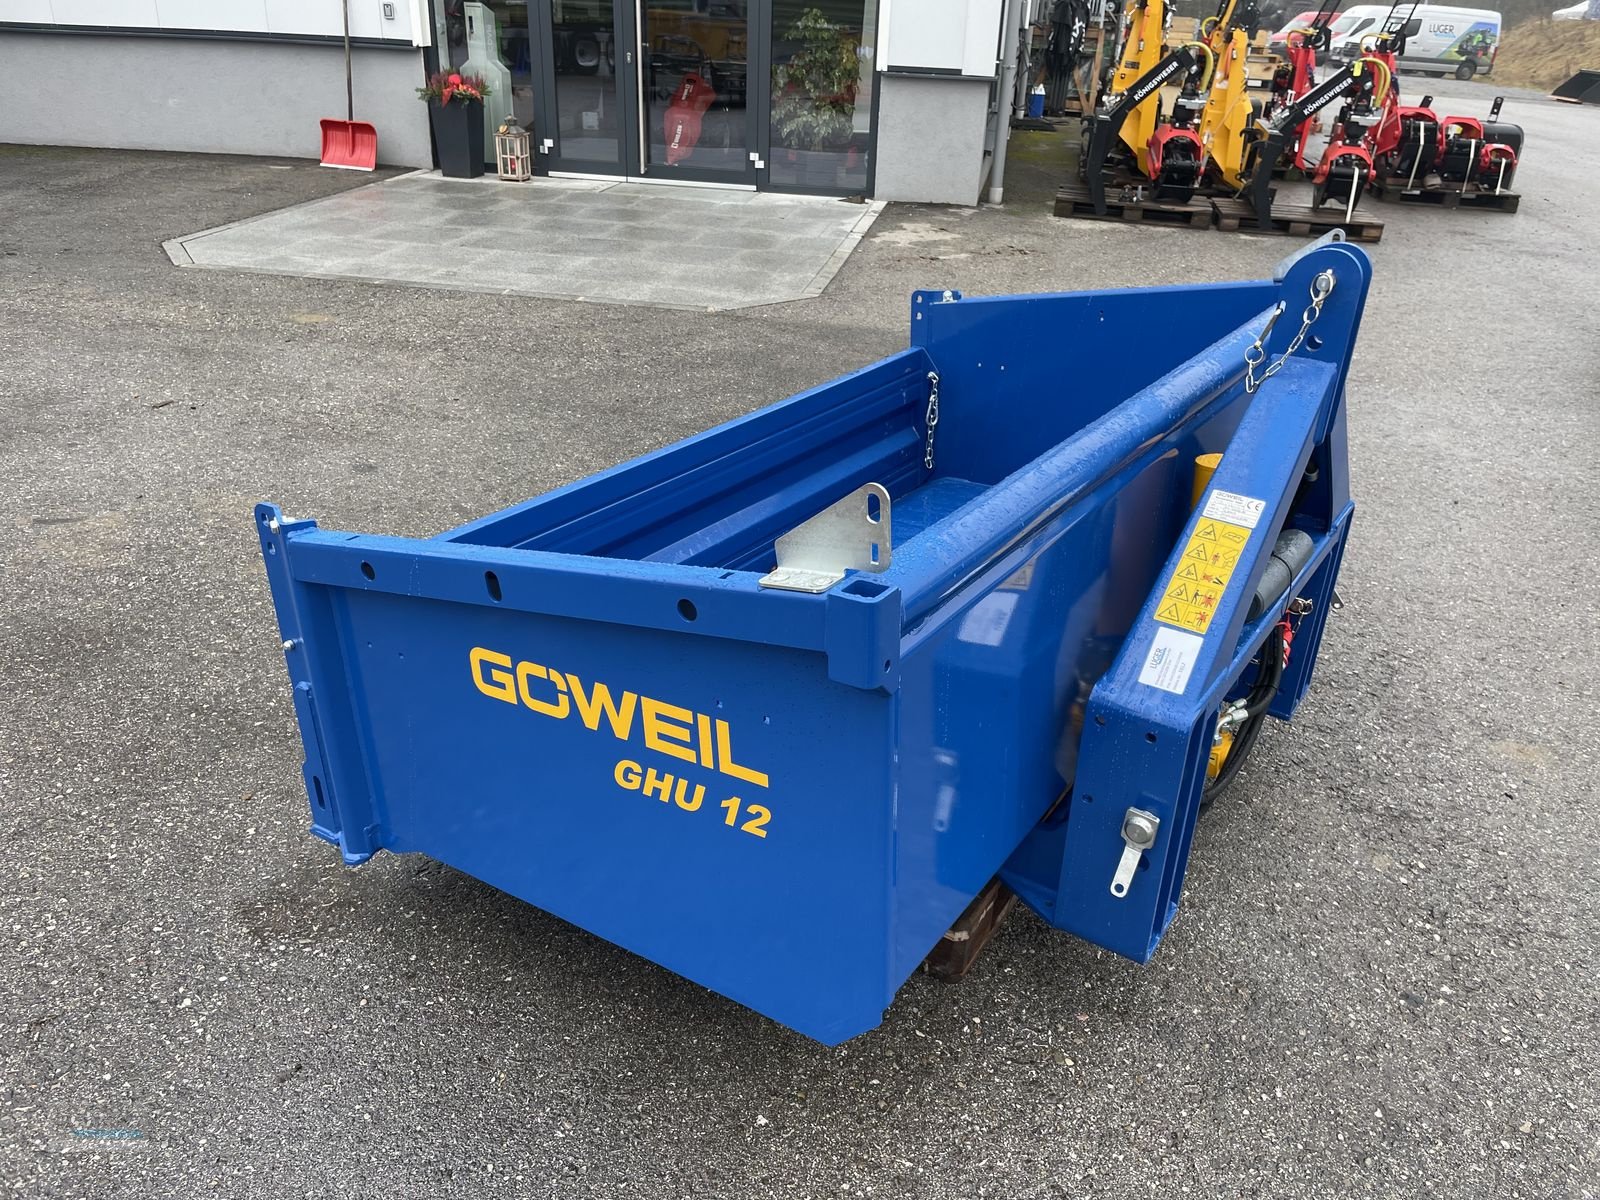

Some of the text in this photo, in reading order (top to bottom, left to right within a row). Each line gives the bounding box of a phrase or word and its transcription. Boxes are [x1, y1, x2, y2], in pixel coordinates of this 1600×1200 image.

[1428, 23, 1455, 34] LUGER
[1133, 61, 1179, 101] KÖNIGSWIESER
[1303, 77, 1353, 116] KÖNIGSWIESER
[613, 759, 772, 838] GHU 12
